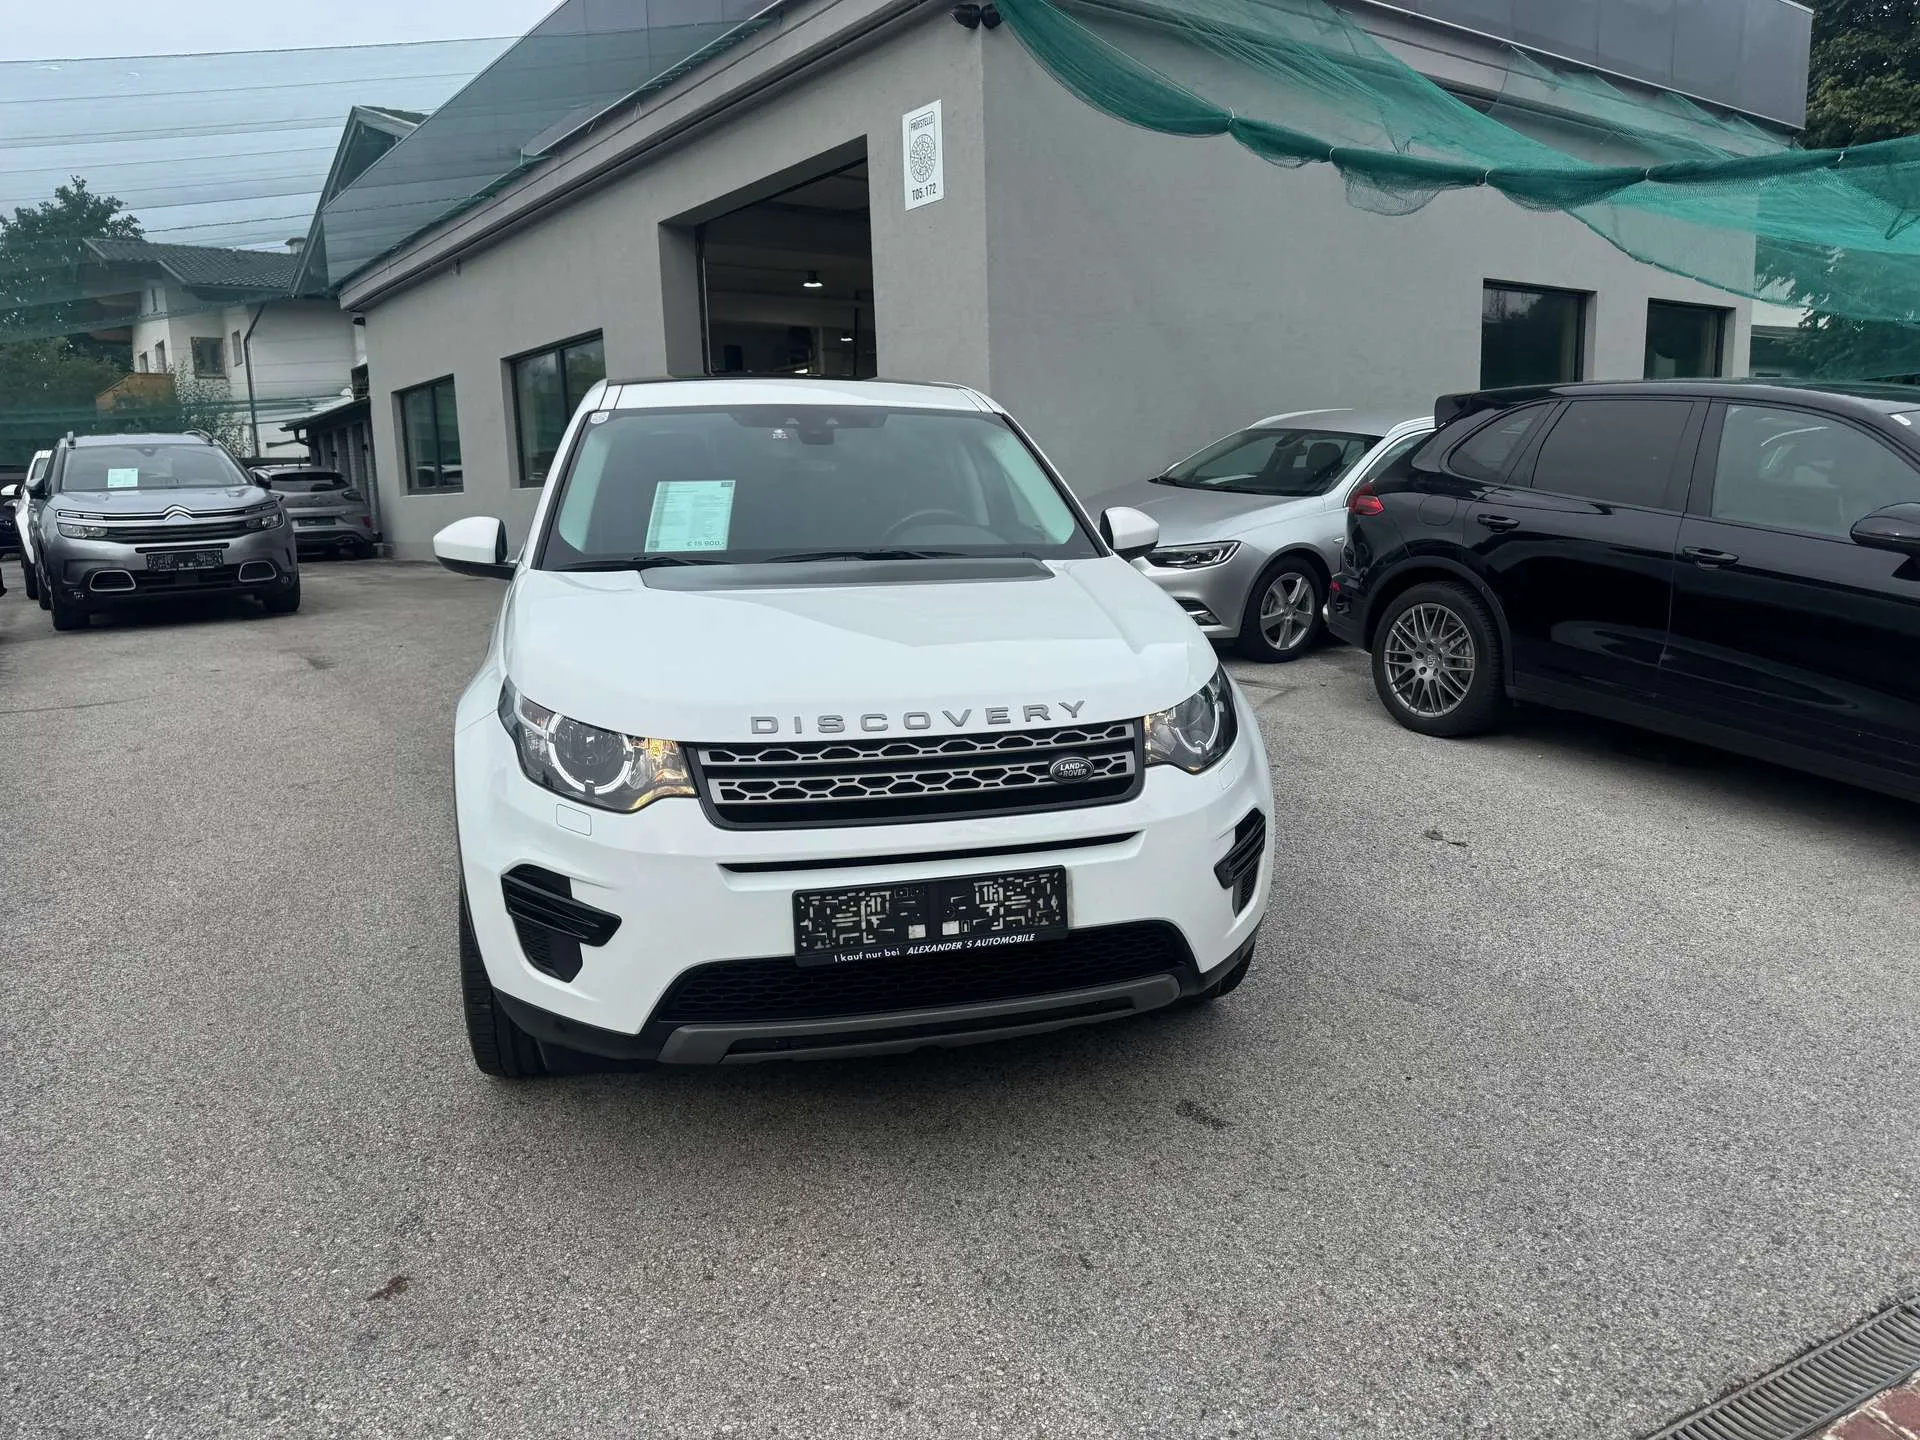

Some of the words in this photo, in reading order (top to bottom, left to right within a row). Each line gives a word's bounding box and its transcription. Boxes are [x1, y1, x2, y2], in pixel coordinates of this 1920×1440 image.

[750, 700, 1086, 735] DISCOVERY
[840, 951, 863, 963] kauf
[865, 951, 882, 960] nur
[884, 947, 900, 958] bei
[974, 933, 1036, 948] AUTOMOBILE
